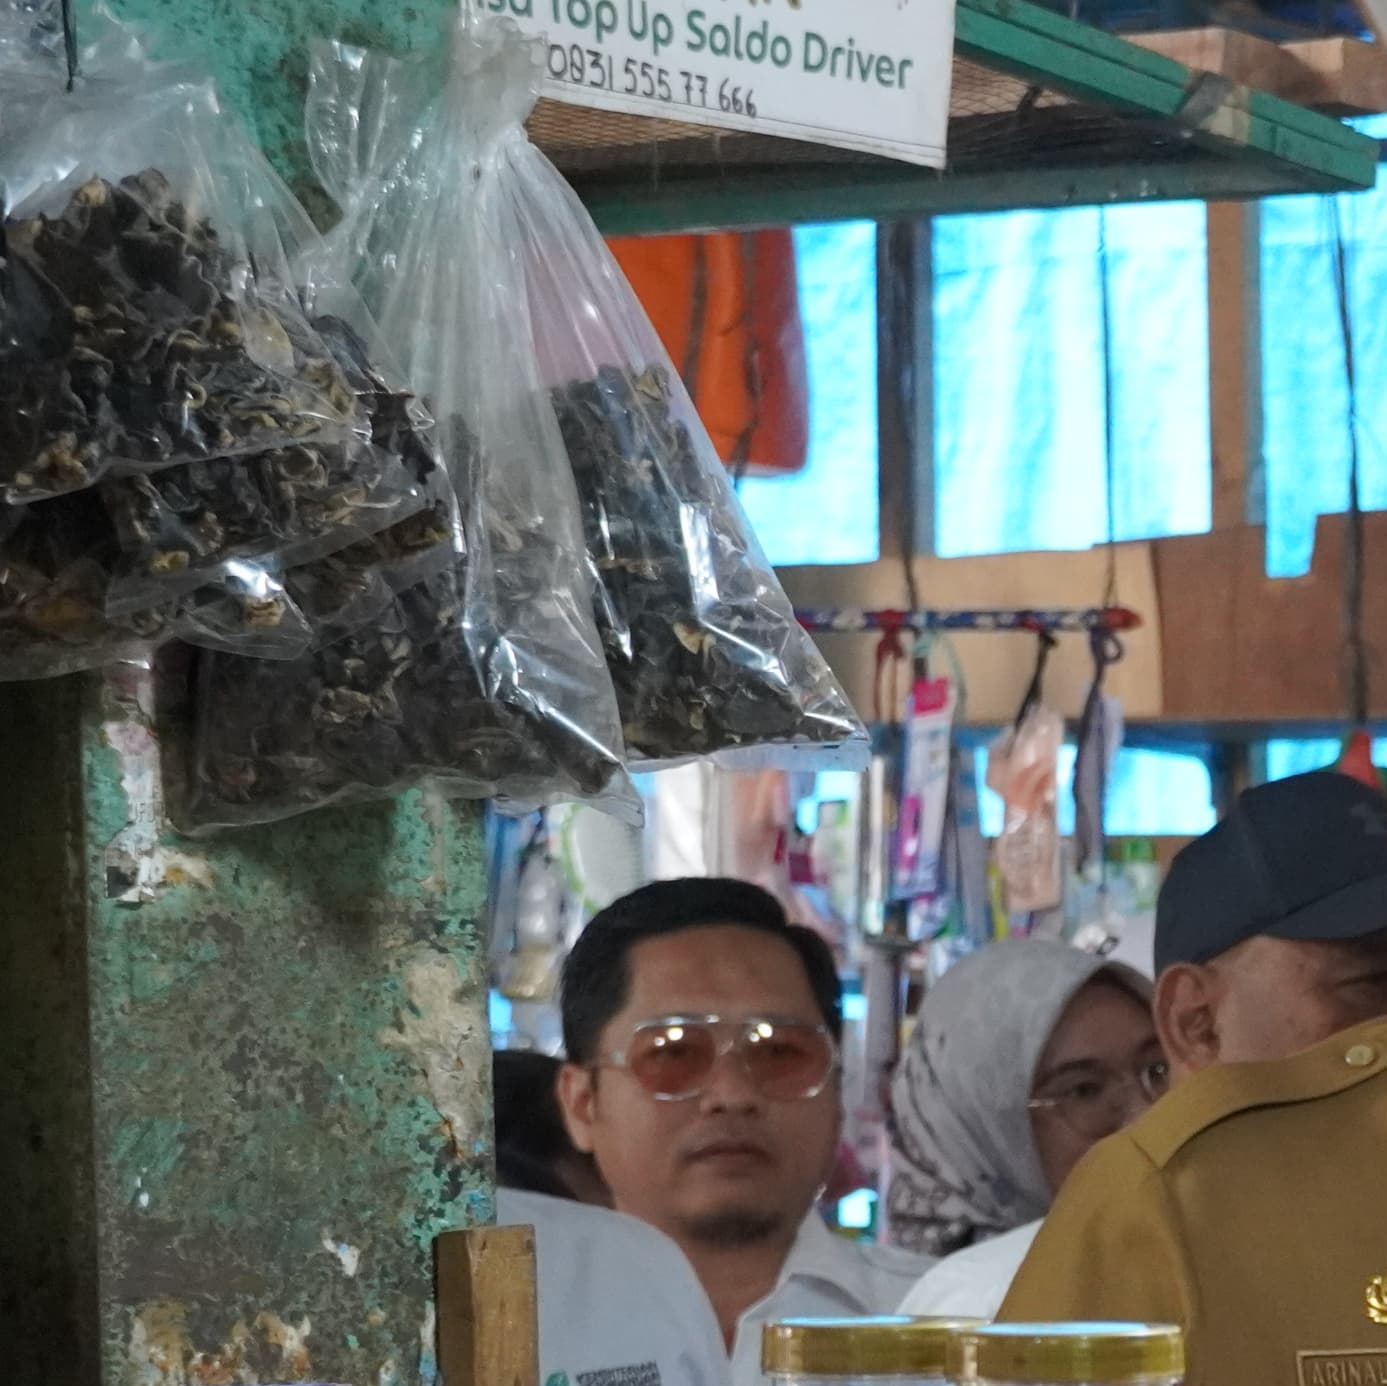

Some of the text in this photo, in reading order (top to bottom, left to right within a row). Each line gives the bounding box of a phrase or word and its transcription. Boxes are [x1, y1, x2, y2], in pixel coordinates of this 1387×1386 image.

[628, 0, 674, 55] Up
[686, 9, 792, 68] Saldo
[803, 31, 913, 89] Driver
[623, 57, 672, 101] 555
[679, 70, 708, 108] 77
[718, 77, 757, 118] 666
